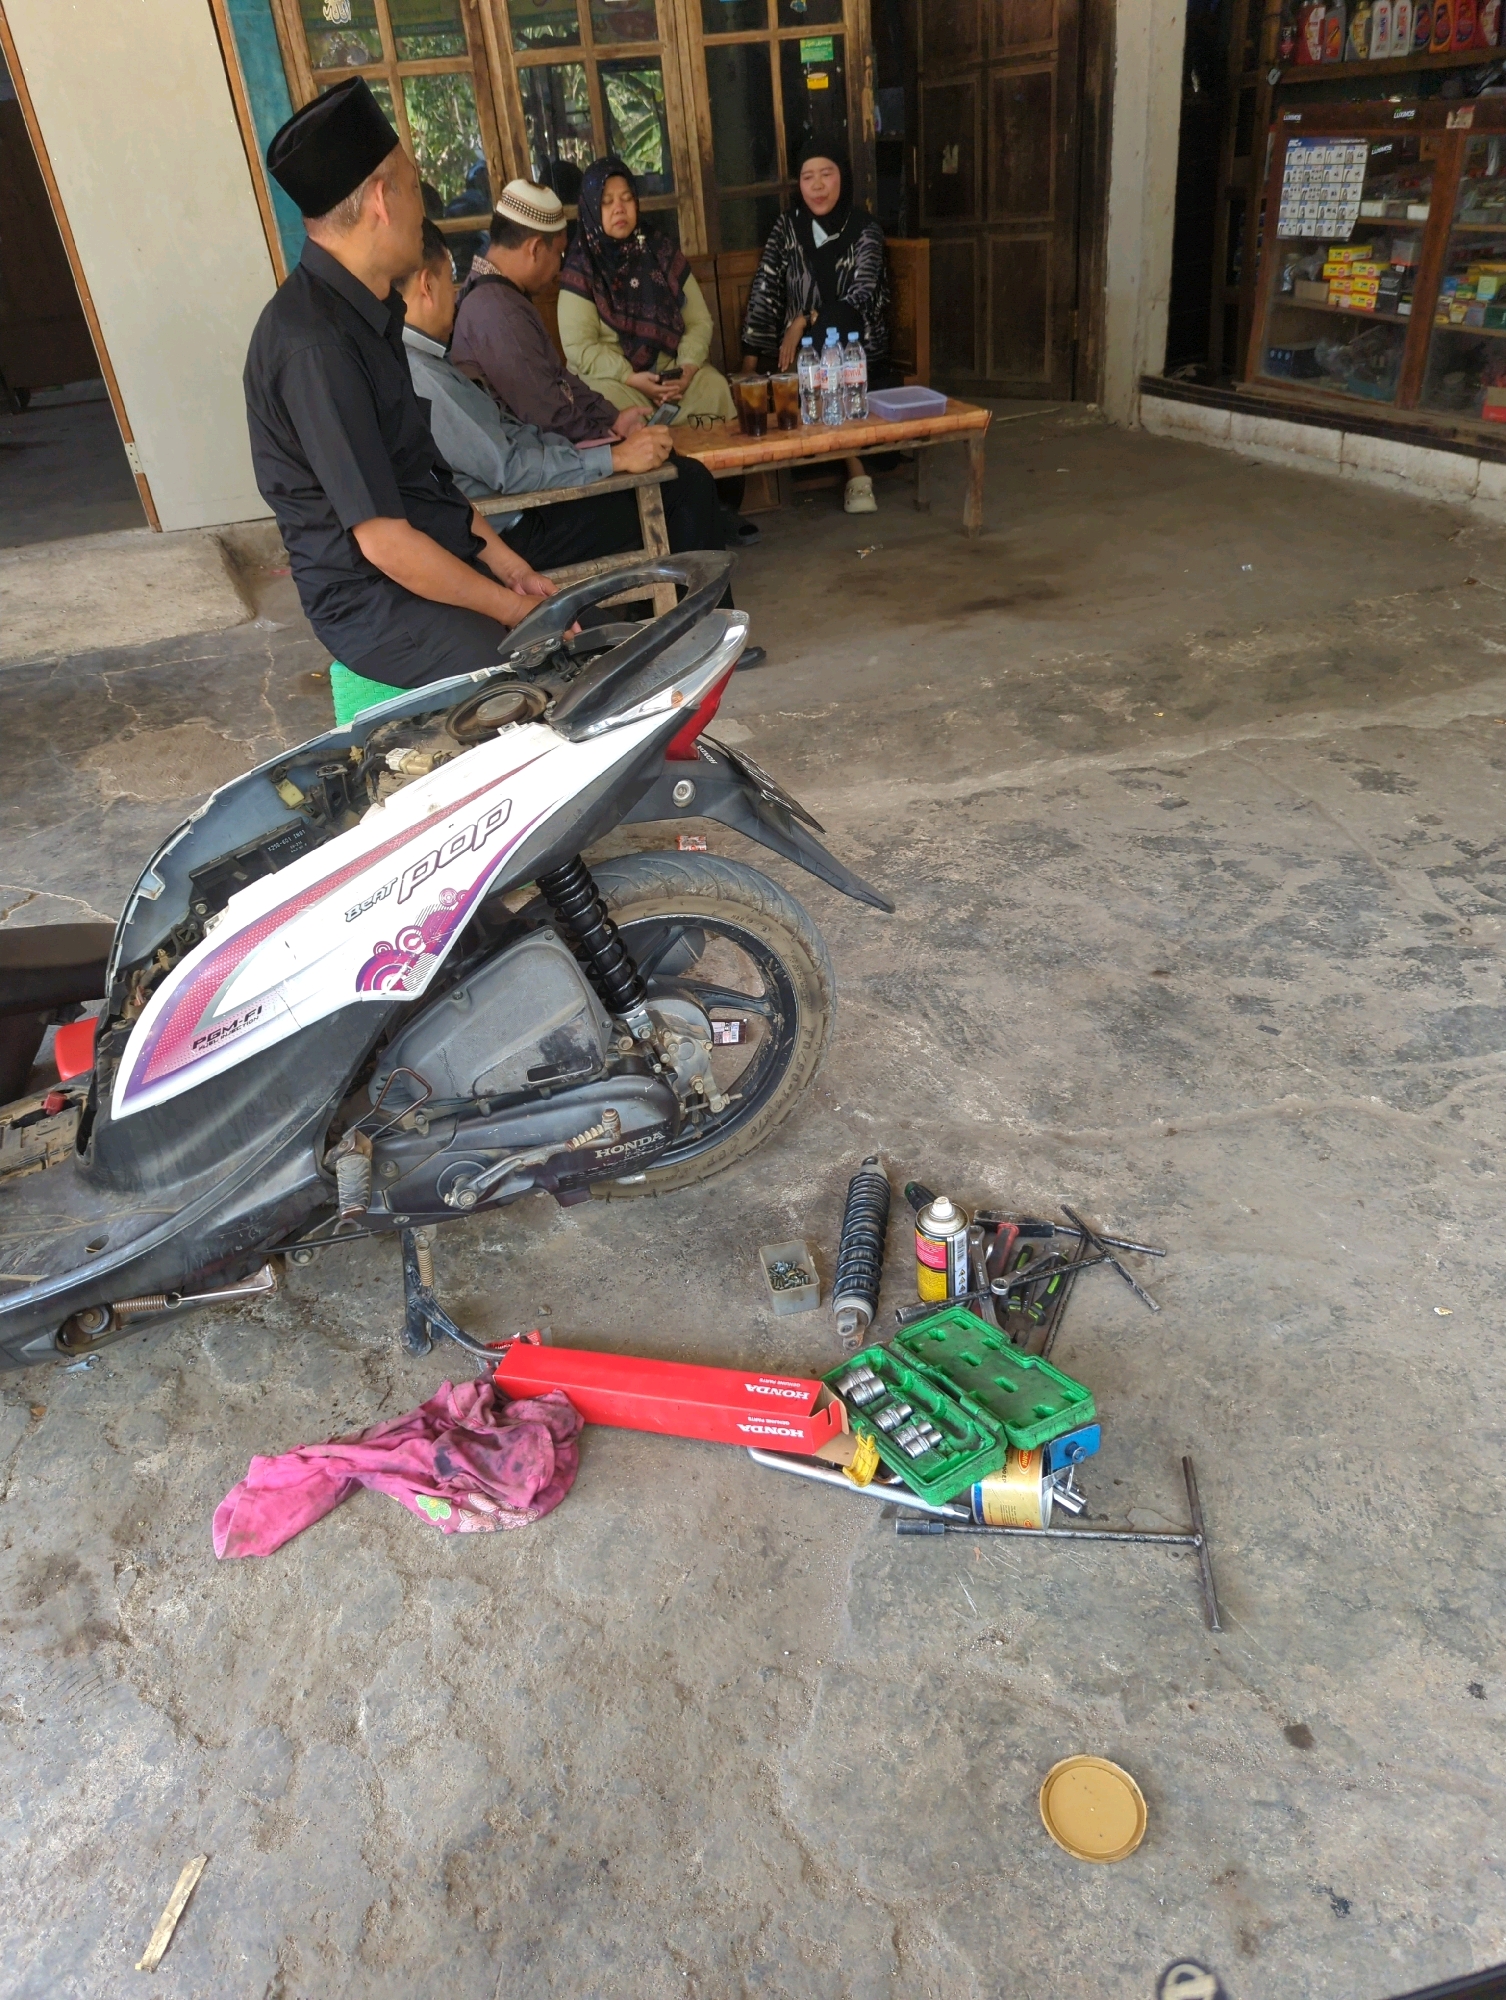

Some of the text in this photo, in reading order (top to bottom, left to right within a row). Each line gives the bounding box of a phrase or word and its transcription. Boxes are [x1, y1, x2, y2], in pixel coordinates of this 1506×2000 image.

[193, 1005, 262, 1049] PGM-FI
[199, 1016, 259, 1050] FUEL INJECTION
[595, 1131, 666, 1159] HONDA
[758, 1377, 801, 1388] GENUINE PARTS
[744, 1383, 810, 1400] HONDA
[766, 1417, 790, 1426] GENUINE
[736, 1423, 804, 1438] HONDA
